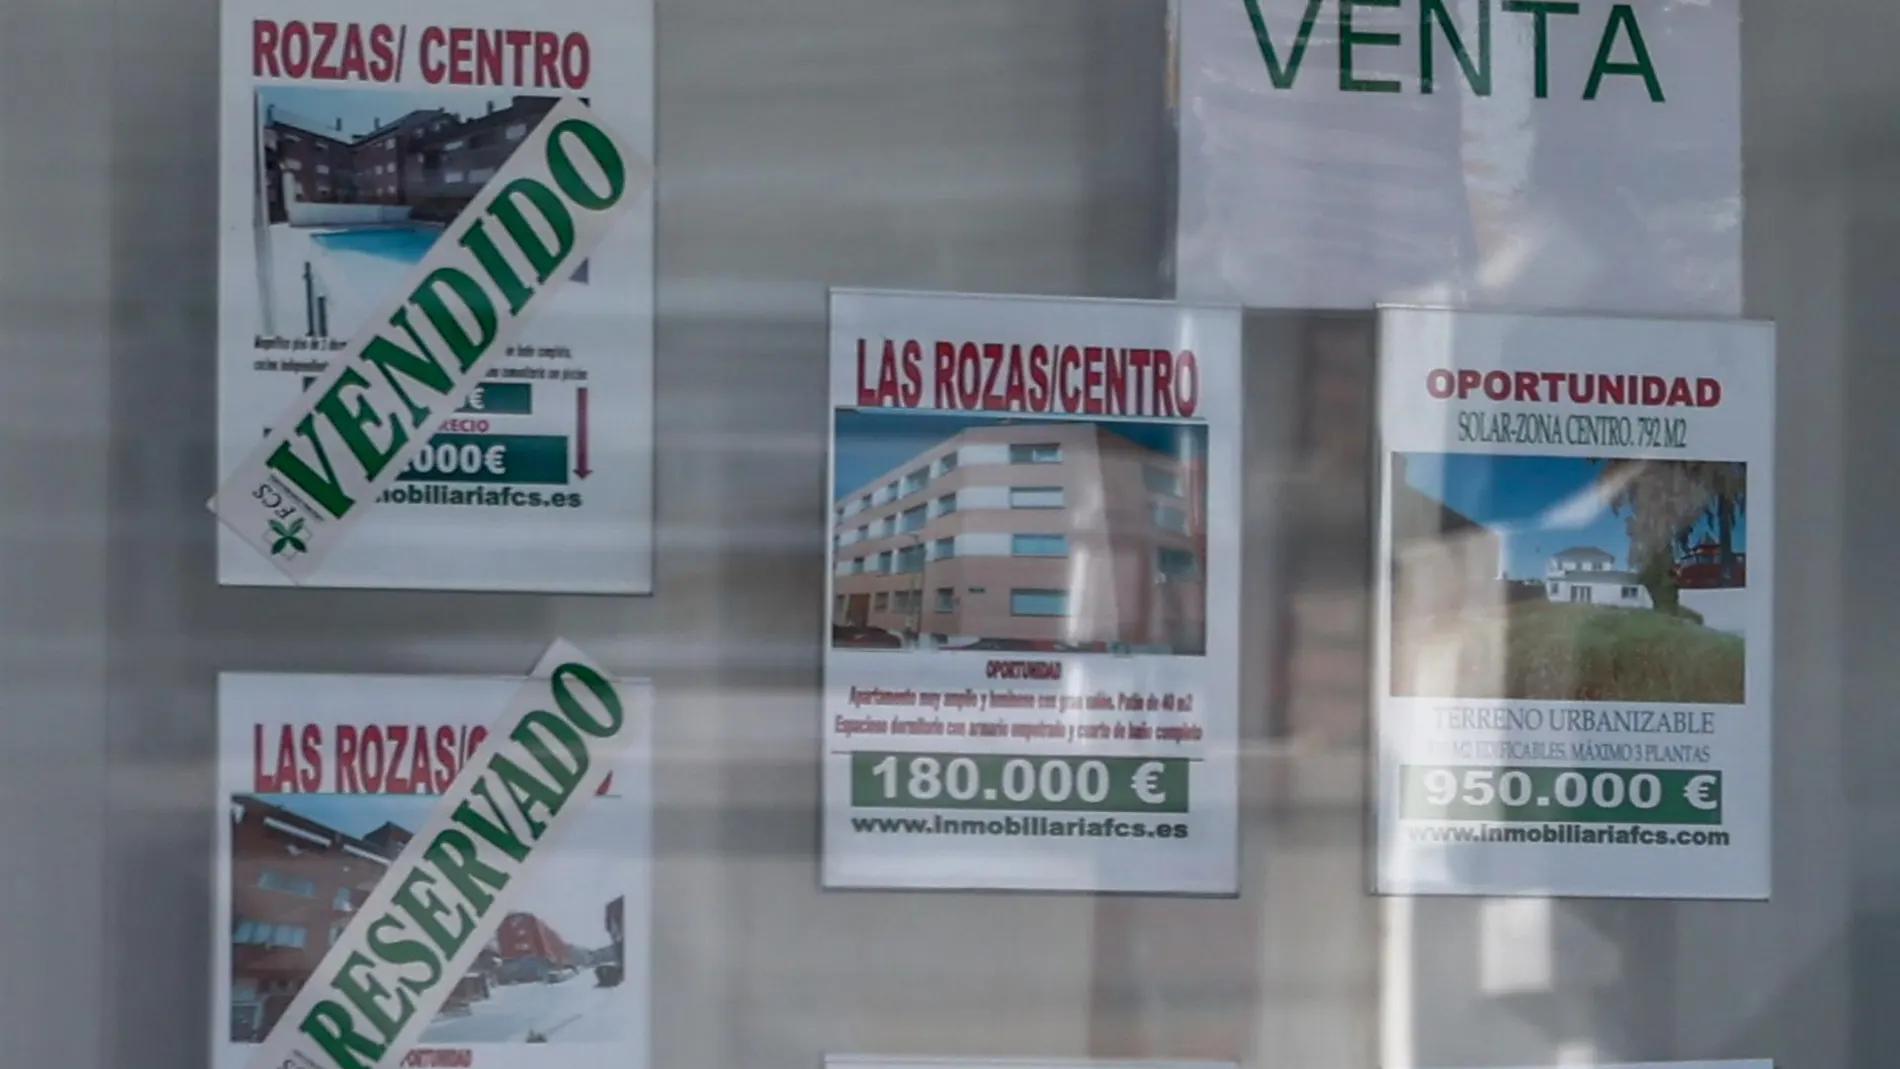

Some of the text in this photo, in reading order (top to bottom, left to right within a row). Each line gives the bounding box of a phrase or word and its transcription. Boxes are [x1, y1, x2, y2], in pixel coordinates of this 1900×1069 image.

[253, 20, 591, 90] ROZAS/ CENTRO
[1243, 0, 1666, 103] VENTA
[266, 118, 626, 520] VENDIDO
[857, 338, 1199, 417] LAS ROZAS/CENTRO
[1426, 368, 1722, 408] OPORTUNIDAD
[1458, 410, 1687, 448] SOLAR-ZONA CENTRO. 792 M2
[1434, 705, 1715, 734] TERRENO URBANIZABLE
[254, 723, 323, 793] LAS
[1645, 744, 1711, 763] PLANTAS
[872, 756, 1166, 804] 180.000 €
[1422, 769, 1717, 810] 950.000 €
[851, 815, 1189, 839] www.inmobiliariafcs.es
[1408, 822, 1730, 846] www.inmobiliariafcs.com
[298, 661, 624, 1069] RESERVADO
